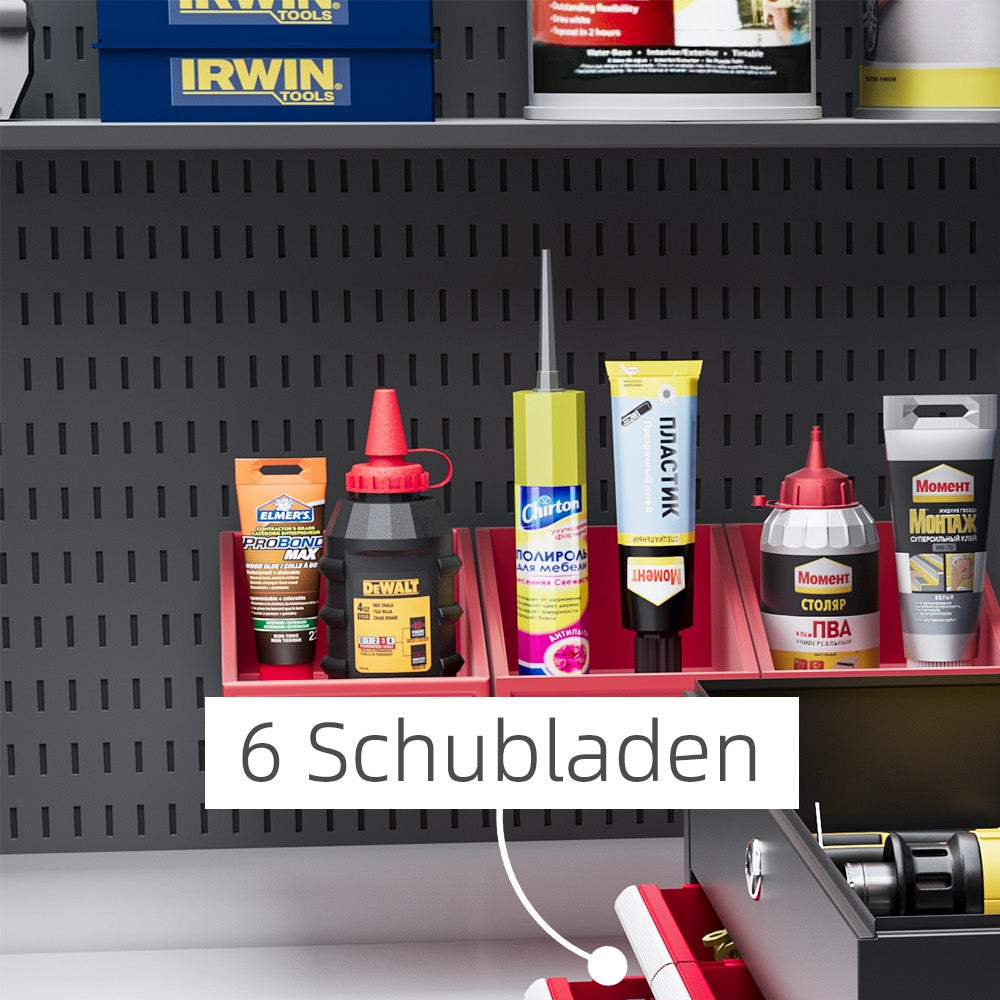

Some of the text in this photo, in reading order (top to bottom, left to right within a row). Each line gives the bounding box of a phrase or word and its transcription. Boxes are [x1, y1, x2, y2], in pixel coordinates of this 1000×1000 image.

[277, 10, 333, 21] TOOLS
[181, 58, 335, 91] IRWIN
[280, 91, 335, 102] TOOLS
[659, 417, 680, 518] ПЛАСТИК
[916, 479, 970, 493] Момент
[260, 510, 312, 520] ELMER'S
[522, 499, 580, 524] Chirton
[284, 548, 319, 560] MAX
[516, 549, 588, 562] ПОЛИРОЛЬ
[540, 562, 587, 573] мебели
[631, 568, 682, 585] Момент
[798, 571, 850, 585] Момент
[357, 602, 363, 612] 4
[801, 598, 847, 612] СТОЛЯР
[813, 619, 851, 638] ПВА
